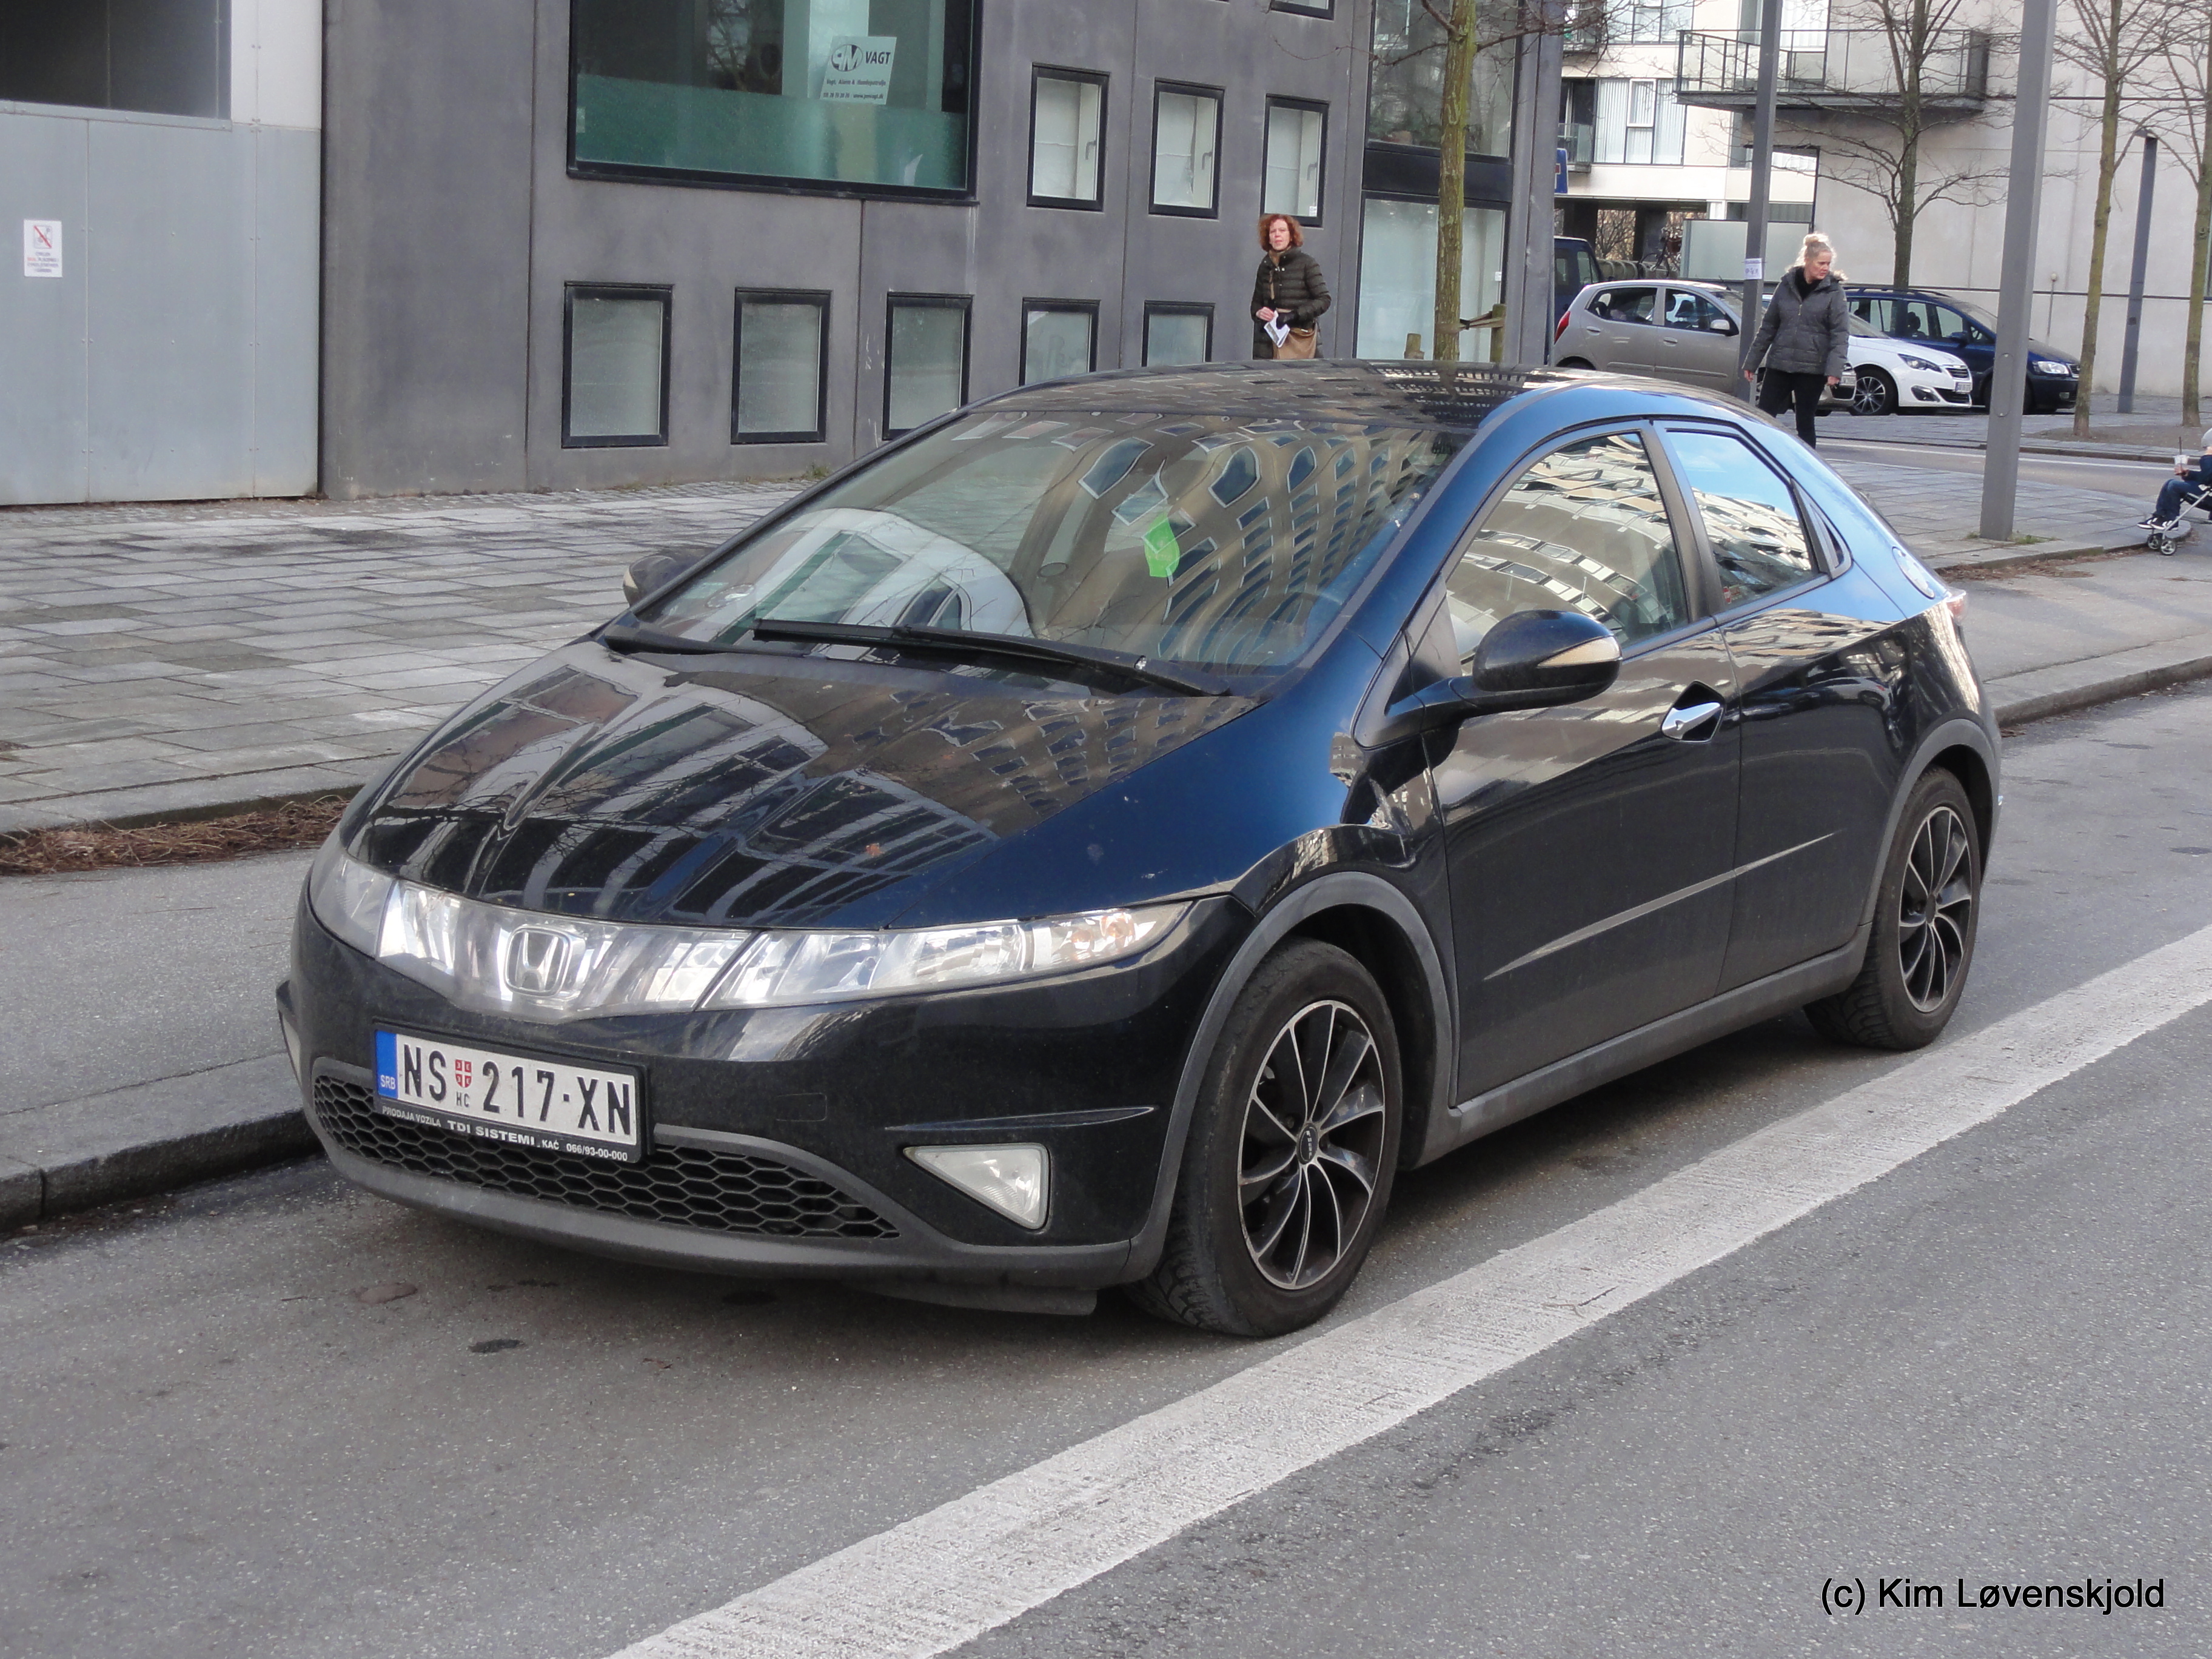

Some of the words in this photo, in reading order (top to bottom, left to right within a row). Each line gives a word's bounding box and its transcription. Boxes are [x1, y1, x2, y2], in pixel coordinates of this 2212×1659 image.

[865, 52, 891, 64] VAGT
[403, 1044, 447, 1101] NS
[380, 1074, 396, 1090] SRB
[456, 1091, 470, 1108] HC
[382, 1105, 414, 1121] PRODAJA
[415, 1113, 441, 1128] VOZILA
[447, 1120, 471, 1133] TDI
[566, 1143, 628, 1162] 066/93-00-000
